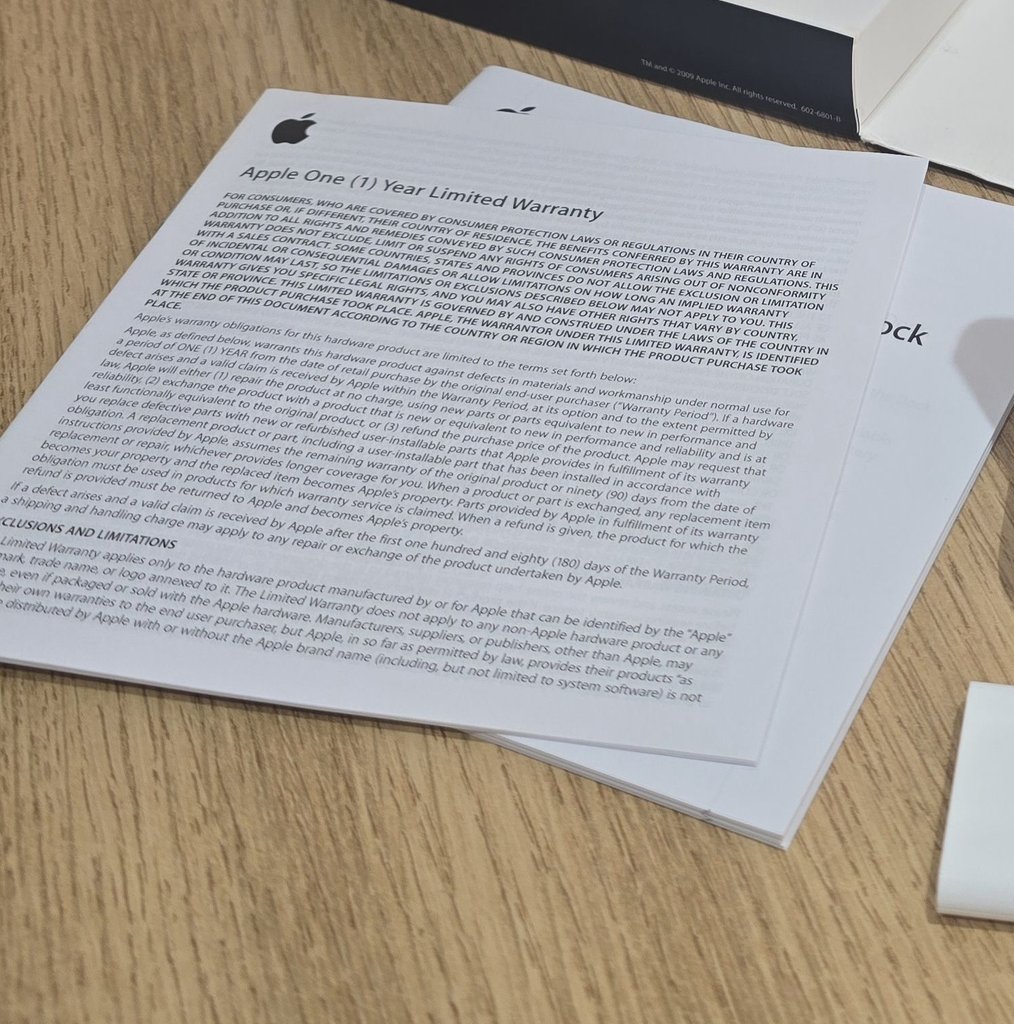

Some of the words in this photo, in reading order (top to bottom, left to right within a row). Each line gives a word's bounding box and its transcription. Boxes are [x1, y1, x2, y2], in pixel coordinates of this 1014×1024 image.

[641, 58, 653, 67] TM
[654, 63, 668, 72] and
[676, 69, 695, 80] 2009
[695, 75, 717, 87] Apple
[718, 81, 730, 91] Inc.
[732, 85, 742, 93] All
[743, 88, 764, 101] rights
[765, 96, 798, 110] reserved.
[239, 166, 299, 182] Apple
[304, 170, 345, 185] One
[350, 175, 377, 191] (1)
[383, 179, 426, 196] Year
[428, 186, 508, 208] Limited
[512, 197, 604, 223] Warranty
[203, 220, 265, 230] WARRANTY
[264, 224, 296, 233] DOES
[296, 227, 322, 237] NOT
[321, 231, 373, 245] EXCLUDE,
[374, 238, 407, 249] LIMIT
[407, 243, 424, 252] OR
[425, 245, 477, 259] SUSPEND
[477, 253, 504, 263] ANY
[504, 257, 546, 269] RIGHTS
[547, 262, 564, 271] OF
[565, 265, 634, 280] CONSUMERS
[635, 273, 681, 285] ARISING
[683, 279, 708, 288] OUT
[709, 281, 726, 290] OF
[727, 283, 827, 301] NONCONFORMITY
[216, 201, 273, 211] PURCHASE
[274, 205, 292, 214] OR,
[306, 208, 366, 223] DIFFERENT,
[368, 216, 400, 227] THEIR
[401, 222, 454, 235] COUNTRY
[455, 229, 471, 237] OF
[471, 231, 533, 247] RESIDENCE,
[536, 240, 558, 250] THE
[559, 243, 610, 256] BENEFITS
[611, 250, 677, 264] CONFERRED
[678, 257, 695, 266] BY
[696, 259, 721, 269] THIS
[723, 262, 785, 276] WARRANTY
[786, 269, 808, 278] ARE
[810, 271, 823, 279] IN
[223, 192, 246, 200] FOR
[247, 194, 314, 206] CONSUMERS,
[316, 199, 344, 209] WHO
[344, 203, 368, 213] ARE
[368, 207, 419, 220] COVERED
[420, 214, 437, 222] BY
[437, 216, 499, 231] CONSUMER
[500, 225, 569, 241] PROTECTION
[570, 234, 601, 245] LAWS
[603, 239, 620, 247] OR
[621, 240, 697, 256] REGULATIONS
[698, 250, 711, 258] IN
[713, 251, 744, 261] THEIR
[746, 255, 799, 267] COUNTRY
[800, 260, 816, 268] OF
[144, 298, 182, 310] PLACE.
[160, 278, 200, 289] WHICH
[200, 282, 223, 291] THE
[223, 283, 280, 296] PRODUCT
[278, 290, 341, 306] PURCHASE
[342, 299, 375, 311] TOOK
[374, 304, 413, 317] PLACE.
[414, 310, 453, 323] APPLE,
[456, 316, 479, 326] THE
[481, 319, 553, 336] WARRANTOR
[555, 329, 596, 341] UNDER
[598, 333, 624, 344] THIS
[625, 337, 672, 350] LIMITED
[674, 342, 740, 359] WARRANTY,
[742, 351, 754, 359] IS
[755, 352, 819, 366] IDENTIFIED
[174, 318, 221, 329] warranty
[222, 321, 282, 335] obligations
[284, 328, 301, 338] for
[302, 332, 322, 342] this
[324, 335, 375, 349] hardware
[376, 345, 421, 356] product
[422, 351, 440, 359] are
[442, 352, 481, 364] limited
[483, 358, 495, 367] to
[497, 360, 515, 369] the
[518, 363, 549, 373] terms
[551, 368, 568, 376] set
[570, 368, 597, 379] forth
[83, 381, 111, 392] least
[111, 384, 176, 401] functionally
[177, 393, 236, 407] equivalent
[238, 400, 250, 409] to
[253, 402, 272, 412] the
[274, 406, 319, 419] original
[368, 421, 382, 429] or
[383, 422, 399, 433] (3)
[401, 425, 440, 437] refund
[441, 430, 461, 440] the
[461, 434, 514, 447] purchase
[515, 441, 545, 451] price
[547, 443, 562, 453] of
[562, 445, 582, 456] the
[633, 454, 668, 466] Apple
[670, 460, 695, 471] may
[697, 463, 741, 474] request
[743, 466, 767, 476] that
[22, 466, 63, 478] refund
[63, 470, 73, 480] is
[73, 473, 128, 486] provided
[128, 480, 159, 491] must
[160, 482, 176, 493] be
[178, 487, 231, 501] returned
[232, 494, 245, 504] to
[247, 496, 283, 510] Apple
[284, 504, 310, 514] and
[310, 505, 364, 522] becomes
[0, 517, 65, 533] CLUSIONS
[64, 526, 96, 538] AND
[96, 529, 178, 549] LIMITATIONS
